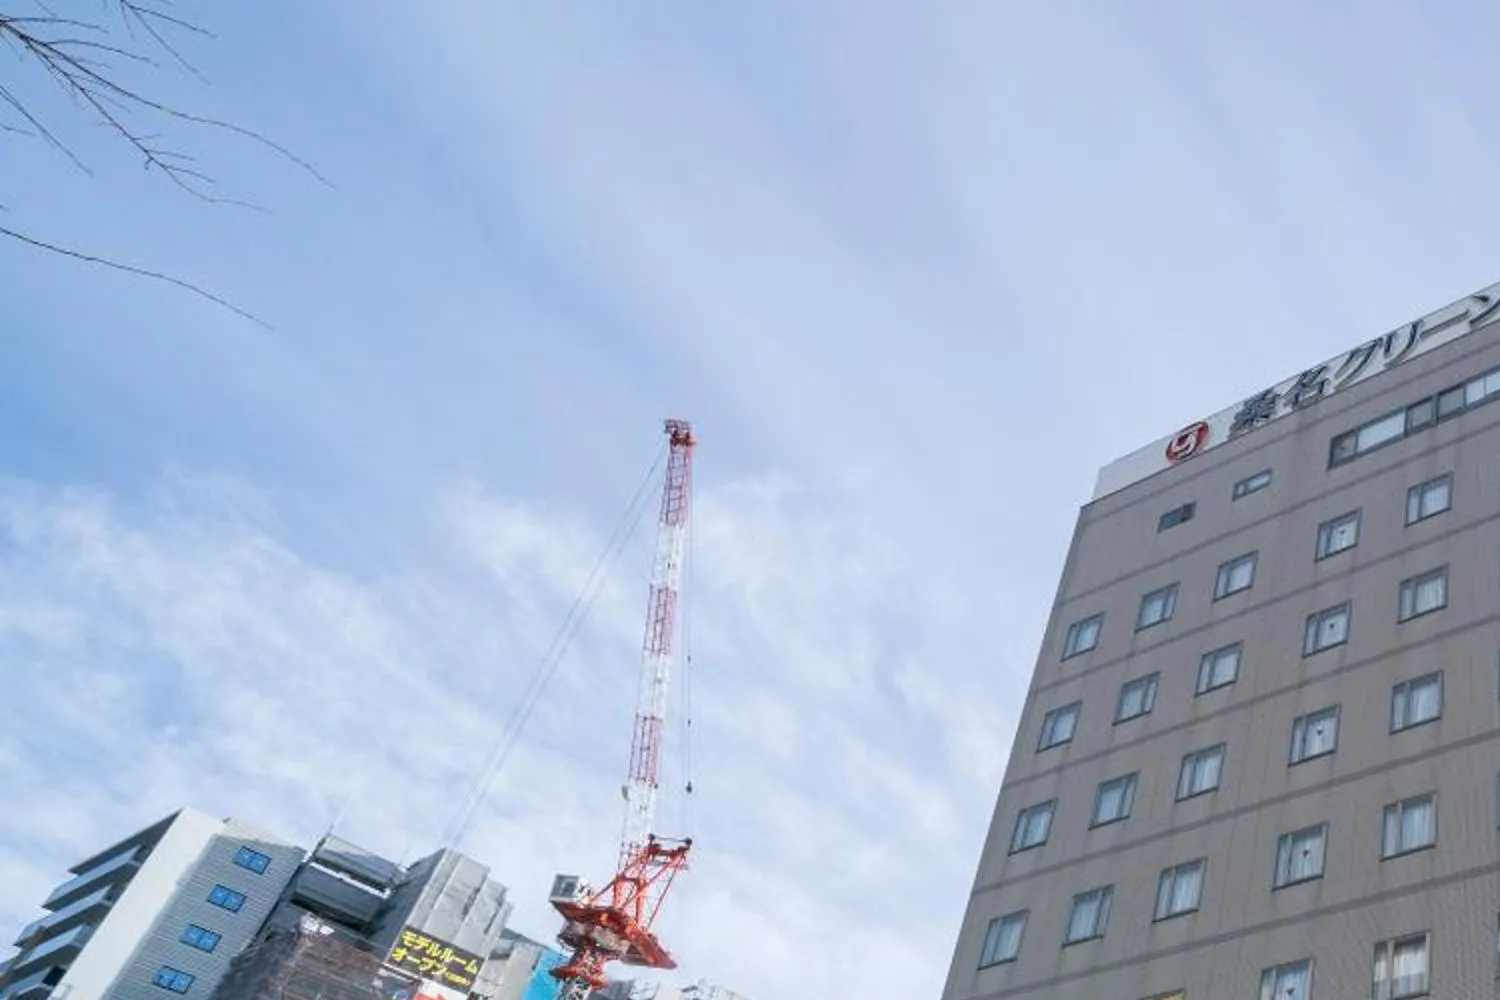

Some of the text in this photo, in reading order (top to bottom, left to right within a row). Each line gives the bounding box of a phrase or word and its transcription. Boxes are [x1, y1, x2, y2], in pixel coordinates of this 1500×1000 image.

[391, 950, 447, 975] オープン
[401, 930, 478, 975] モデルルーム
